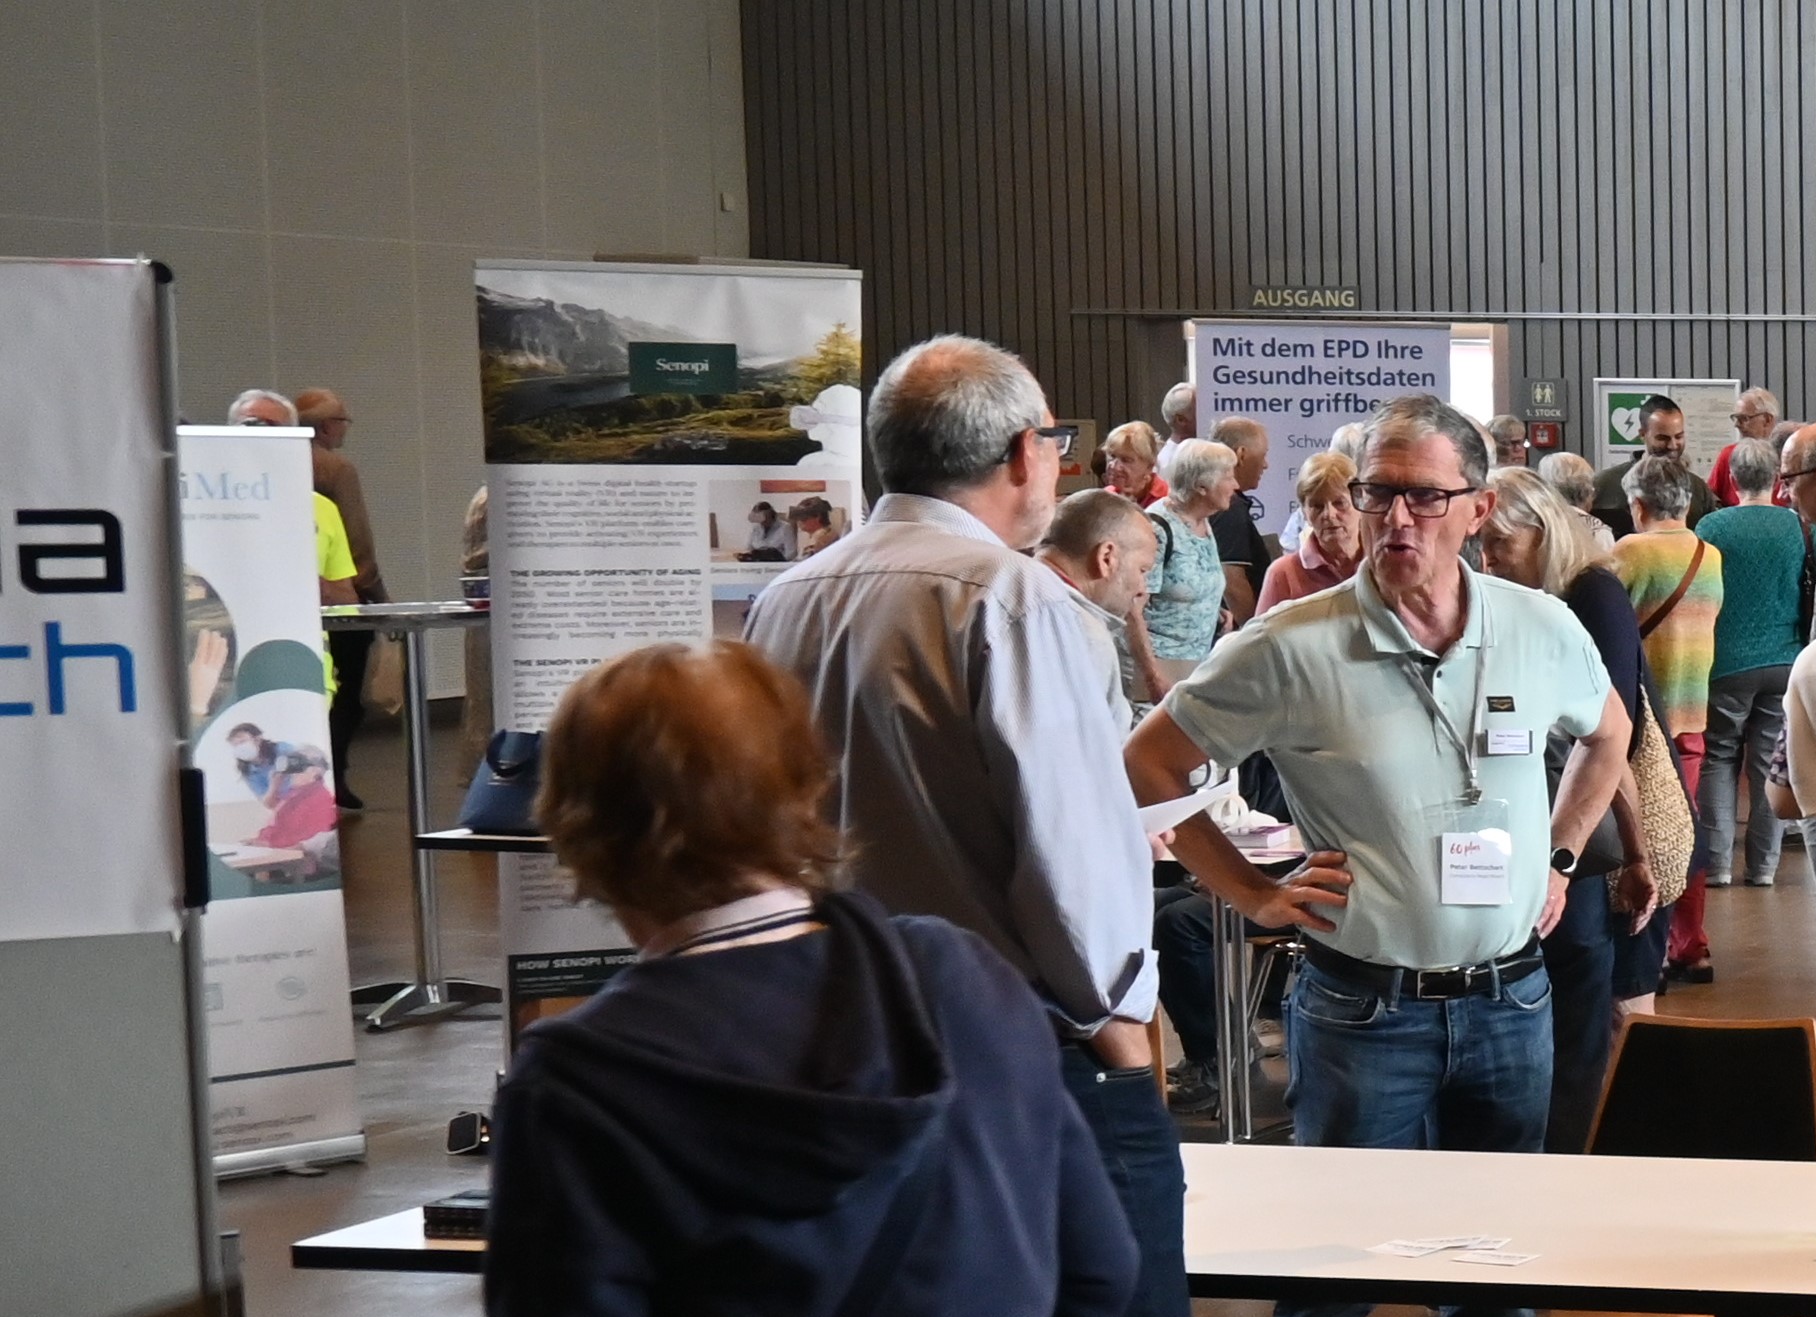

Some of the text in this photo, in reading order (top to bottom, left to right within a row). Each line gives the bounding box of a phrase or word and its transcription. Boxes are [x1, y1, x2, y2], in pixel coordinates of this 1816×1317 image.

[1252, 288, 1356, 308] AUSGANG
[1212, 336, 1424, 361] Mit dem EPD Ihre
[655, 357, 710, 376] Senopi
[1212, 365, 1437, 388] Gesundheitsdaten
[1212, 392, 1382, 418] immer griffbe
[1535, 408, 1562, 418] STOCK
[1286, 433, 1331, 449] Schw
[552, 956, 602, 969] SENOPI
[603, 954, 641, 966] WOR
